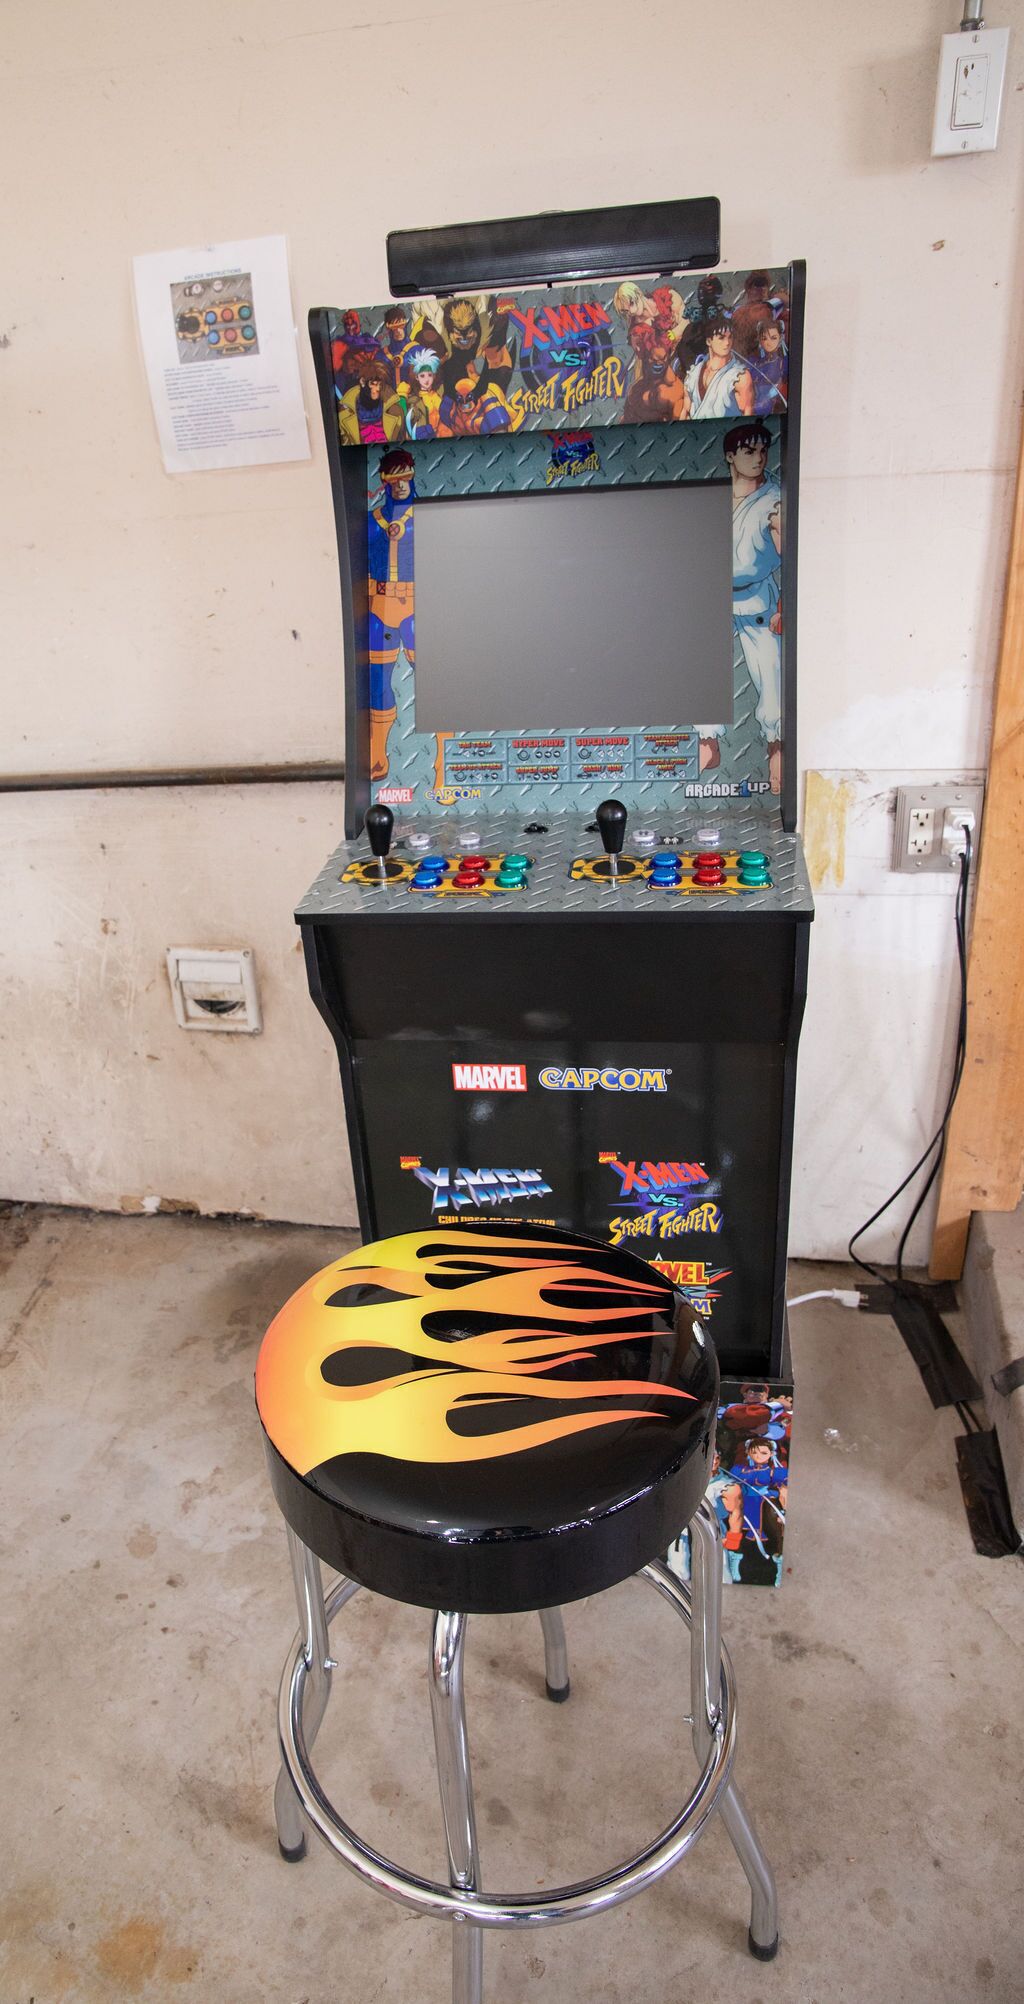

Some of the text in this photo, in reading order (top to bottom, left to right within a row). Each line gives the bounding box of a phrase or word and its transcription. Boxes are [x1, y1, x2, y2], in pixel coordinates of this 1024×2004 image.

[509, 303, 613, 356] X-MEN
[511, 356, 626, 432] STREET FIGHTER
[512, 738, 565, 748] HYPER MOVE
[576, 737, 629, 746] SUPER MOVE
[379, 788, 413, 803] MARVEL
[425, 789, 481, 800] CAPCOM
[452, 1064, 527, 1091] MARVEL
[413, 1167, 553, 1214] X-MEN
[610, 1162, 710, 1196] X-MEN
[649, 1193, 684, 1207] VS.
[609, 1203, 723, 1247] STREET FIGHTER
